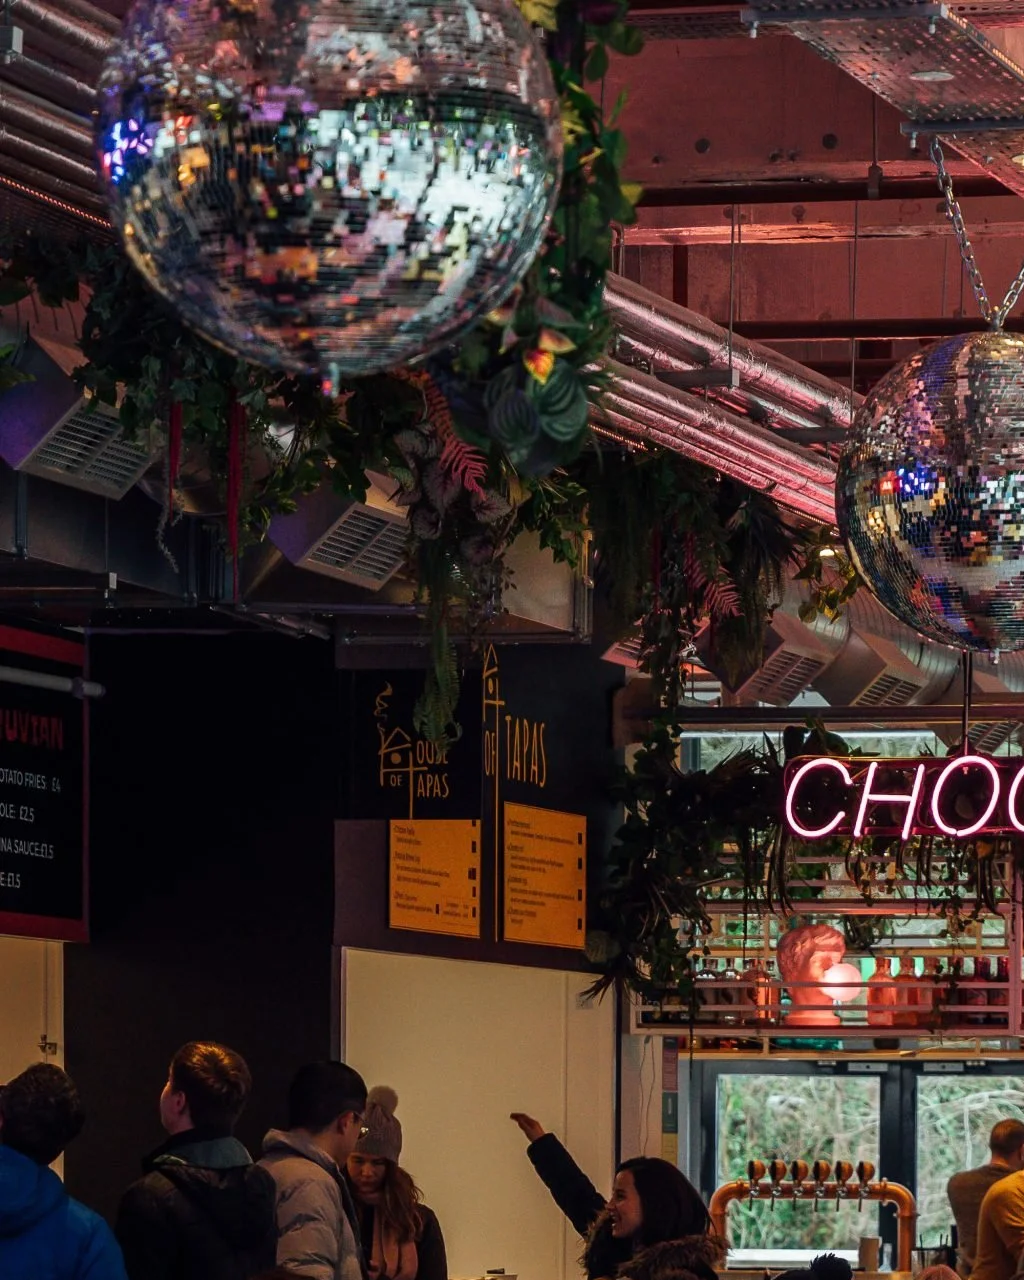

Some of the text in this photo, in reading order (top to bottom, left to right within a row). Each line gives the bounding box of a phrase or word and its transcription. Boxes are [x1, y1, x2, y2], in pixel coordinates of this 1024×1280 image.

[485, 713, 547, 788] OF TAPAS
[390, 774, 403, 787] OF
